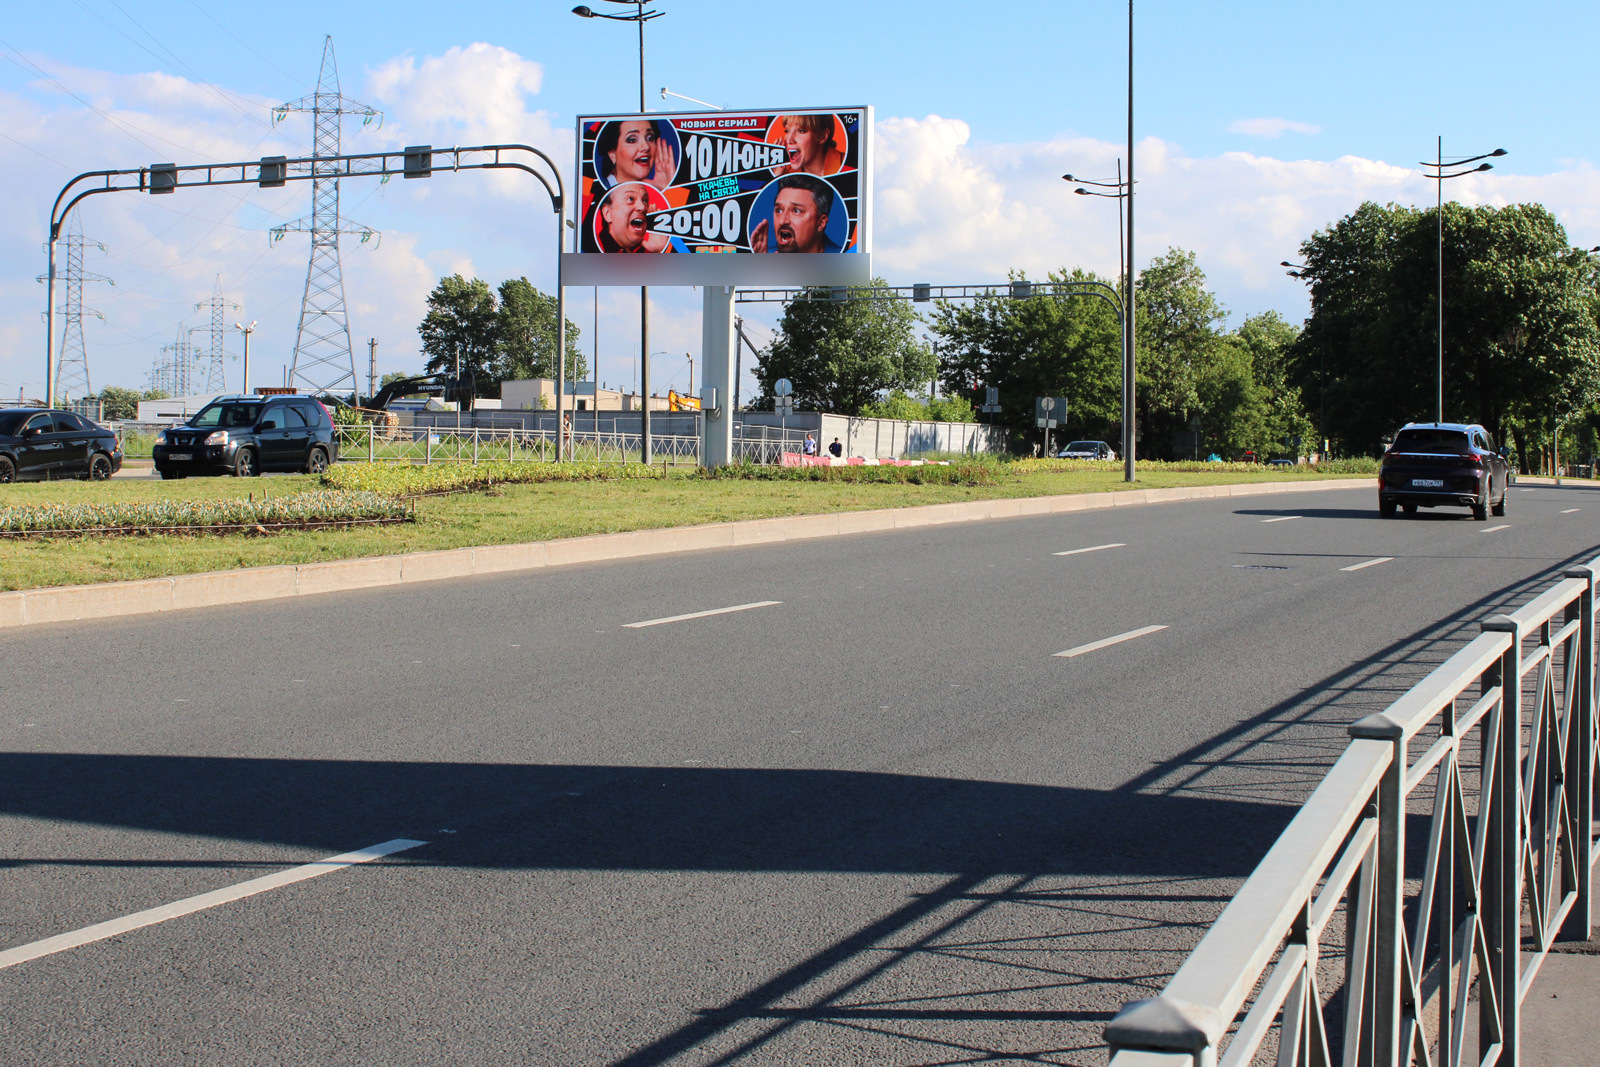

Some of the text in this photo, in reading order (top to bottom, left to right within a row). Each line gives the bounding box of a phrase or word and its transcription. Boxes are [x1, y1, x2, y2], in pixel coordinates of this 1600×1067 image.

[680, 118, 758, 129] НОВЫЙ СЕРИАЛ
[843, 114, 858, 124] 16+
[685, 134, 785, 182] 10 ИЮНЯ
[697, 175, 739, 193] ТКАЧЁВЫ
[698, 184, 741, 202] НА СВЯЗИ
[653, 199, 742, 243] 20:00
